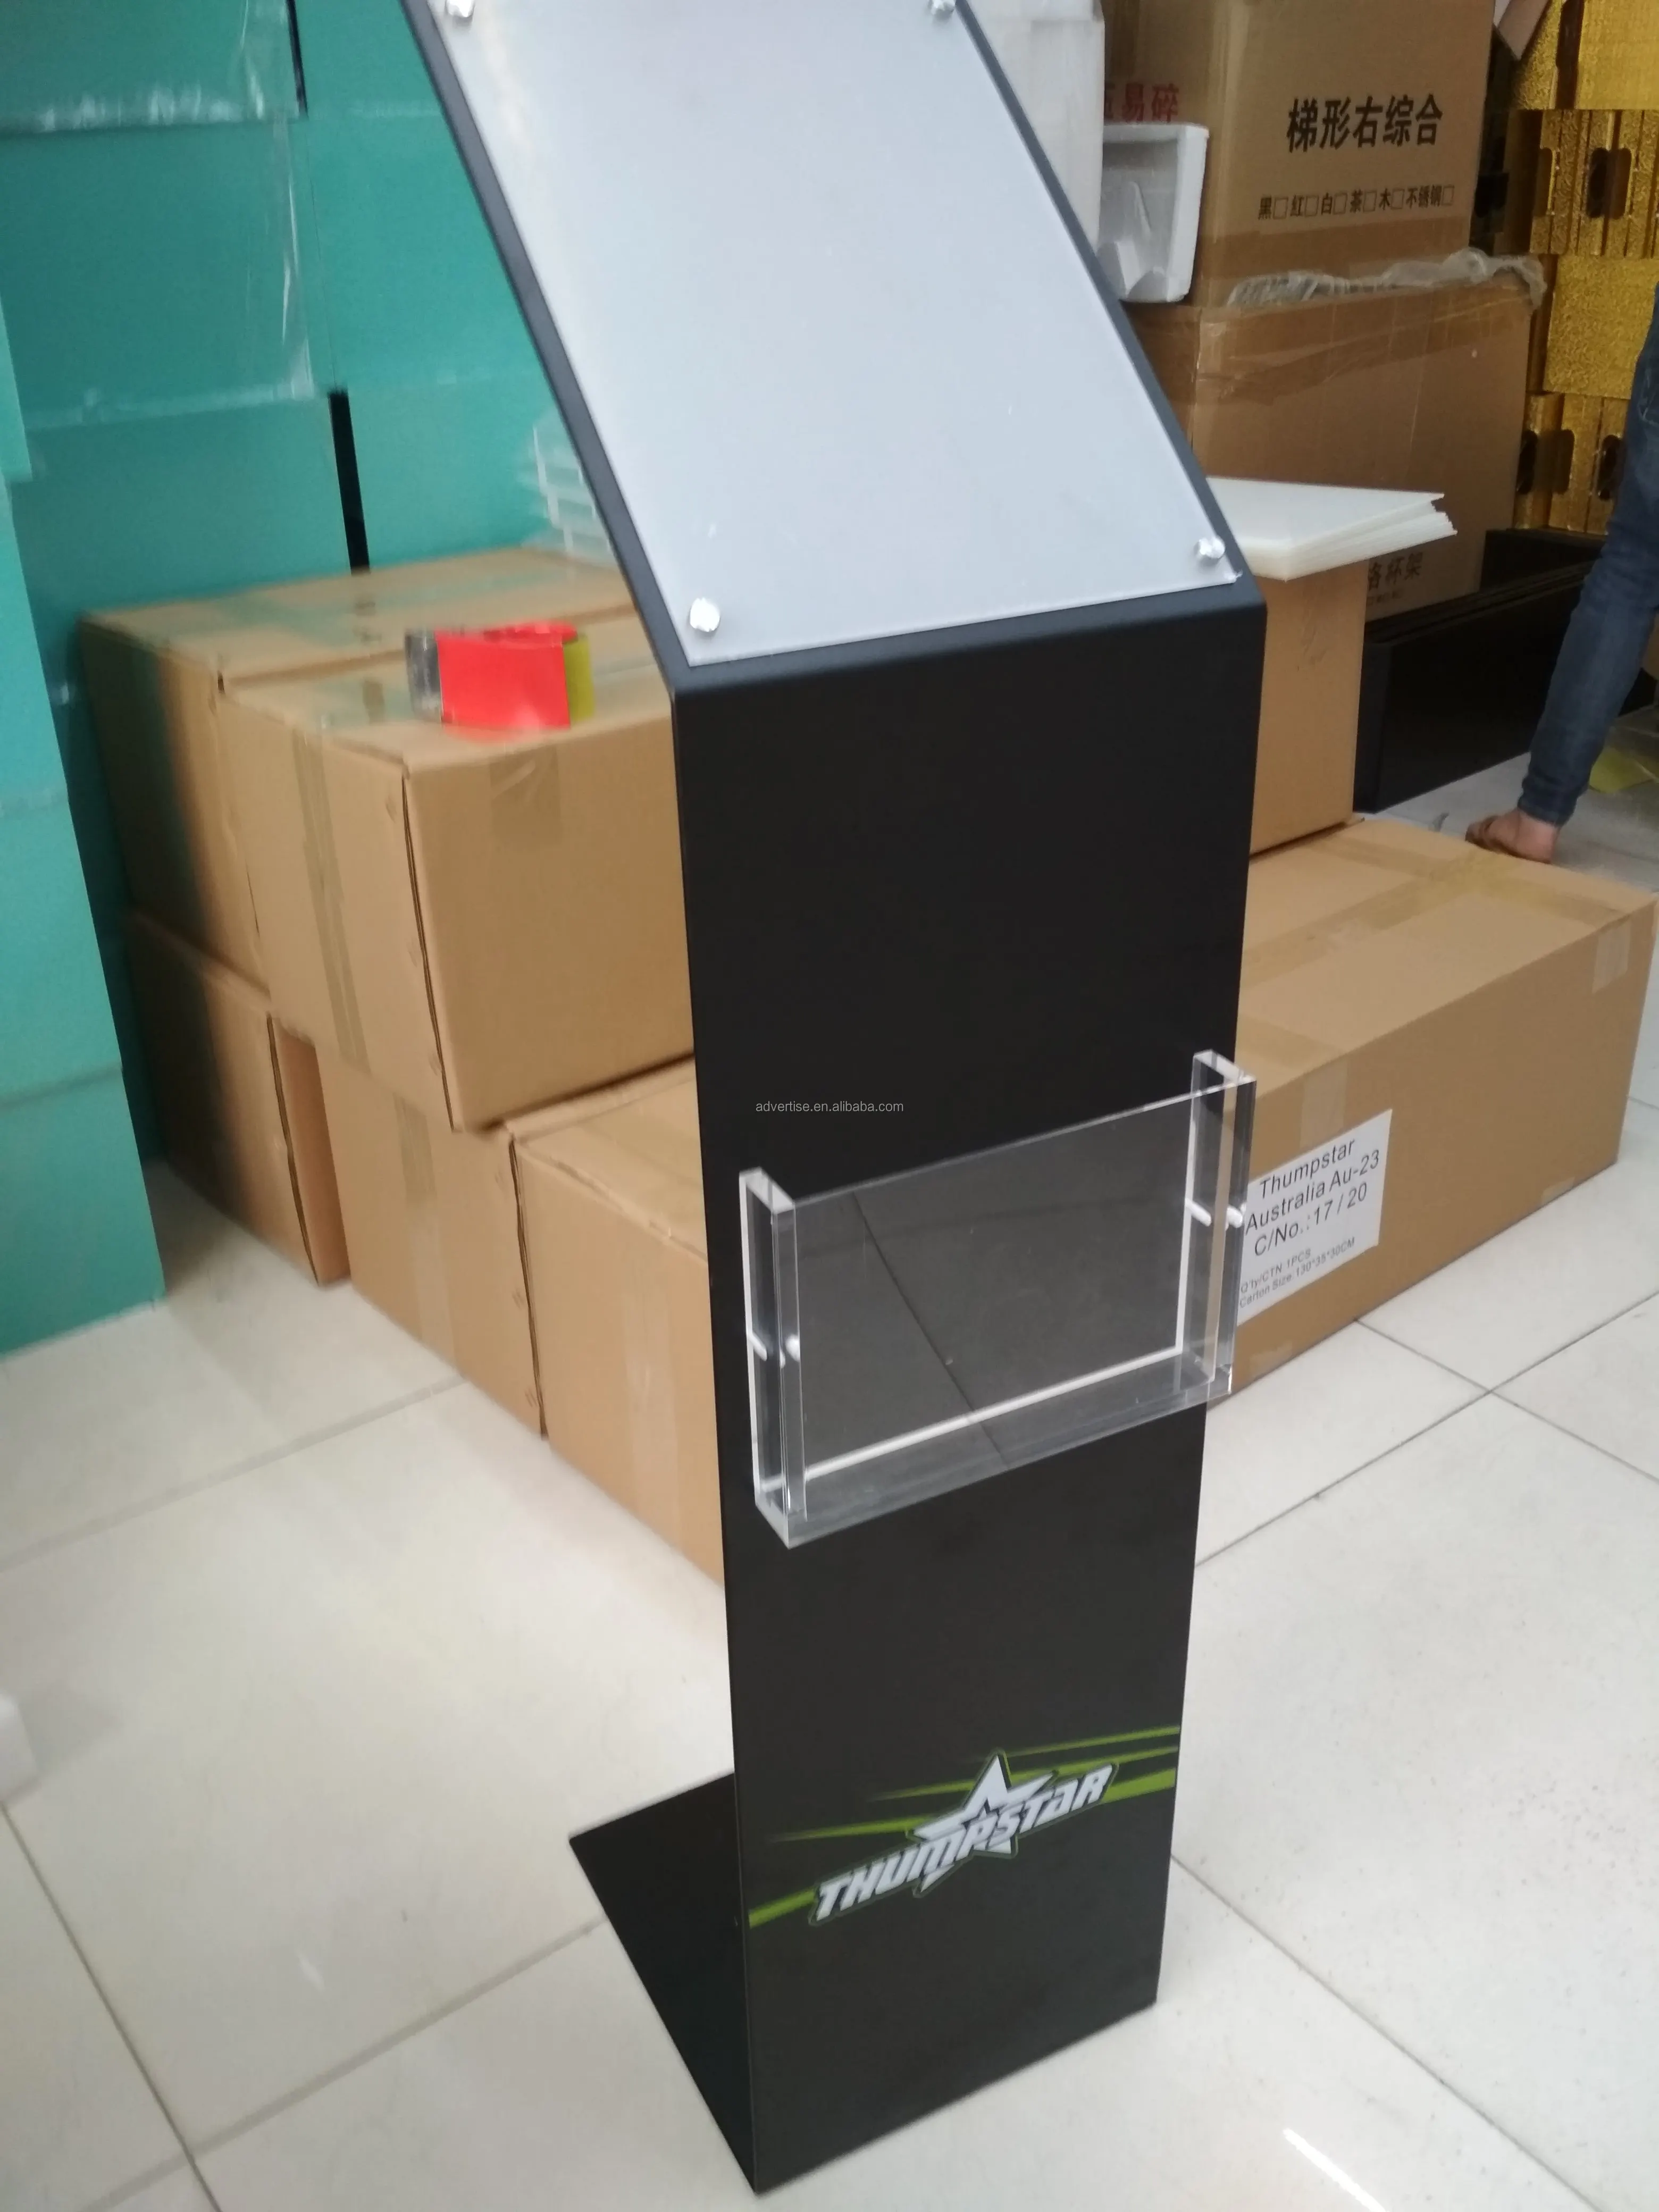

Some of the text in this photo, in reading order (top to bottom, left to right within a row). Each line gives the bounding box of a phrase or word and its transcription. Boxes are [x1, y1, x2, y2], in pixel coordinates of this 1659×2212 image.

[1287, 94, 1443, 153] 梯形右综合
[1245, 1149, 1380, 1236] Australia Au-23
[1260, 1138, 1355, 1199] Thumpstar
[815, 1763, 1115, 1921] THUMPSTAR
